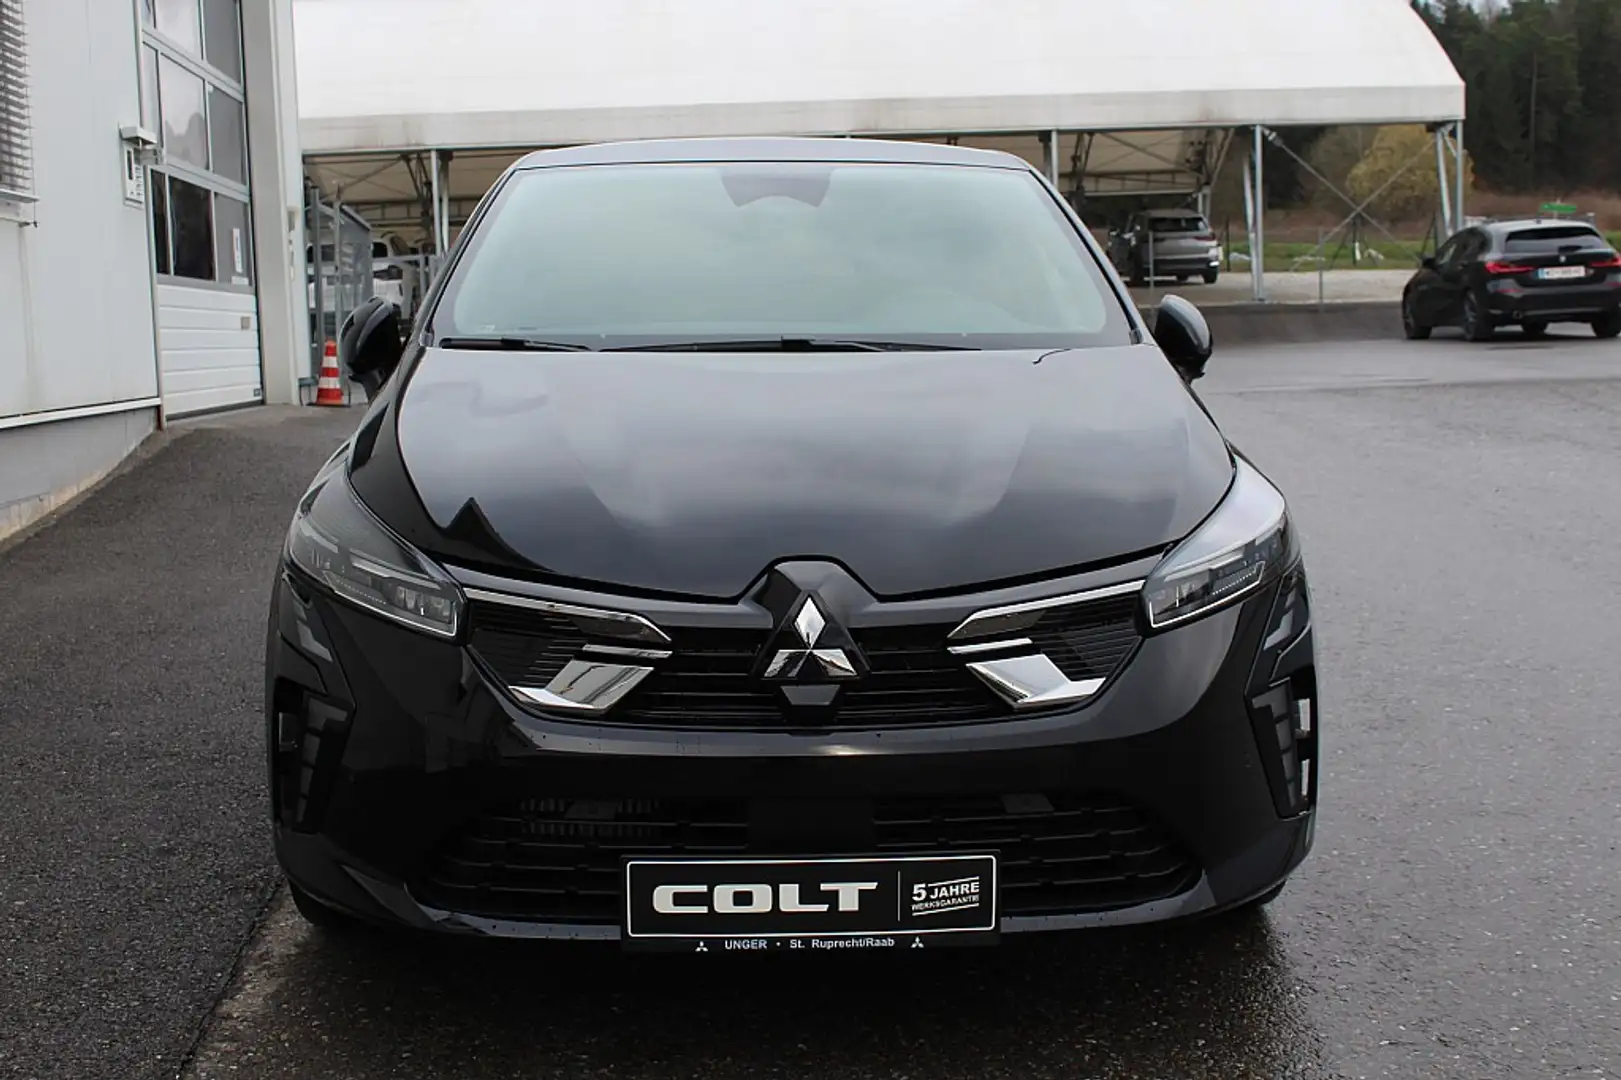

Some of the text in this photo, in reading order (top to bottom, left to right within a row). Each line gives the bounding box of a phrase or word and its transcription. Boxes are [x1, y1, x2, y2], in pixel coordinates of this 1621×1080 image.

[652, 881, 878, 913] COLT
[912, 882, 980, 901] 5 JAHRE
[724, 937, 895, 950] UNGER St. Ruprecht/Raab
